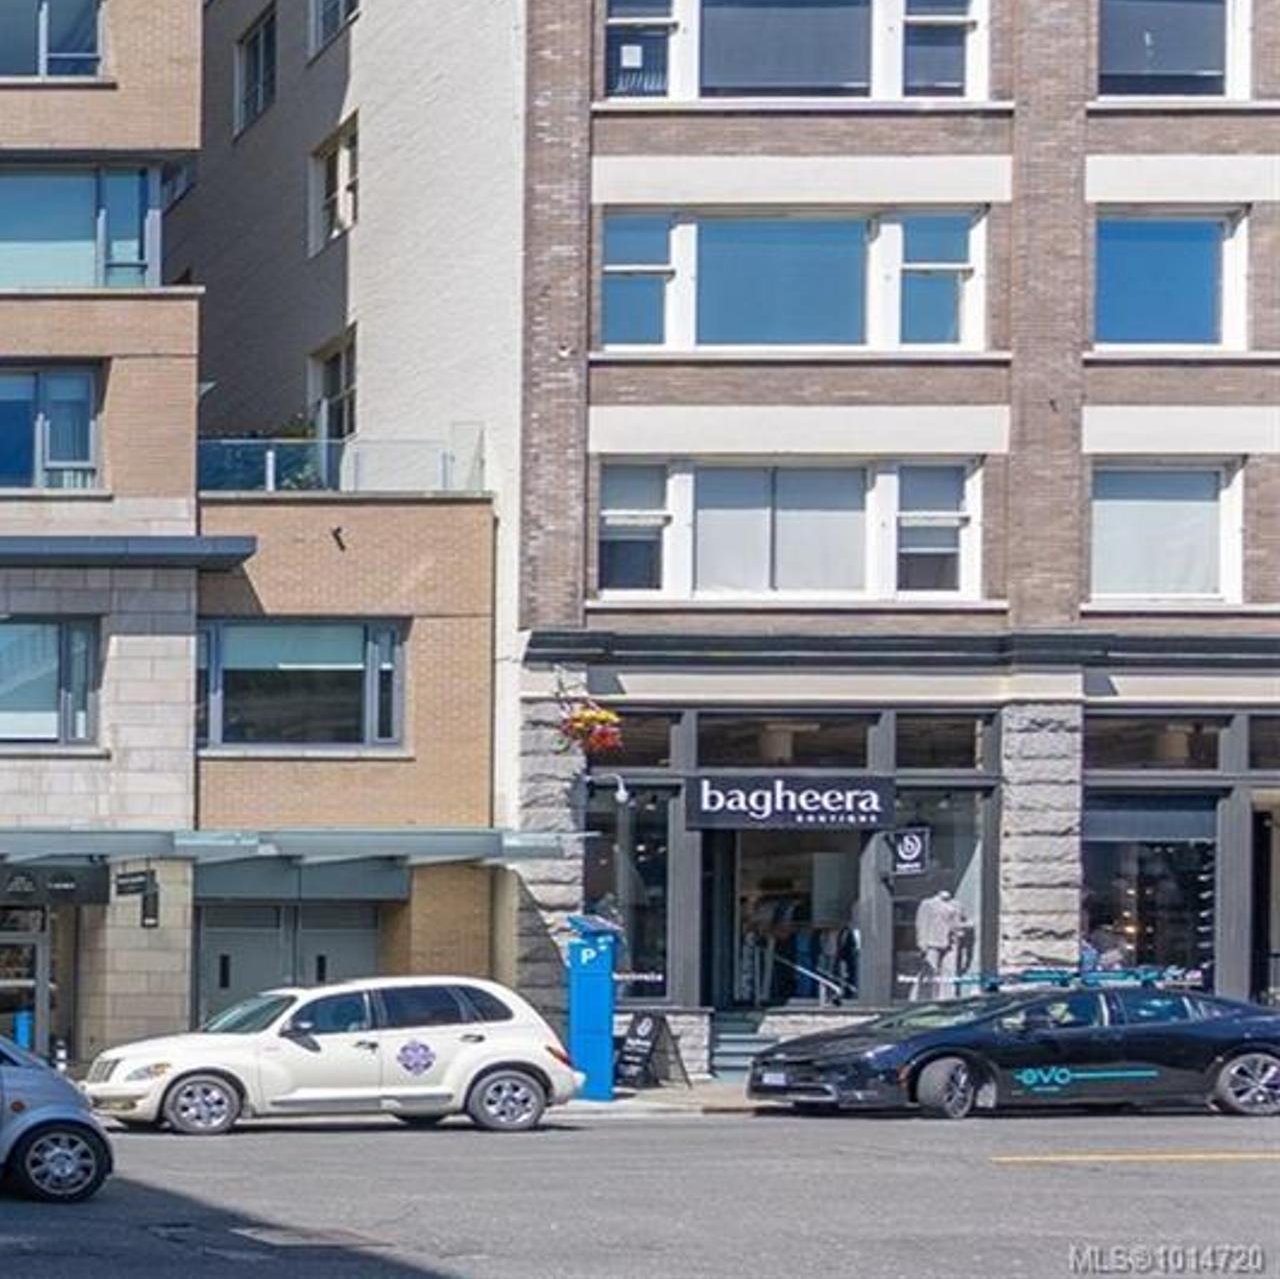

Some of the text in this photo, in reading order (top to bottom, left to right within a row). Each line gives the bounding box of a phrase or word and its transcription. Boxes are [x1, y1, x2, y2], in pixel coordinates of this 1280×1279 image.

[701, 779, 883, 820] bagheera
[581, 947, 597, 965] P
[1020, 1066, 1072, 1085] evo
